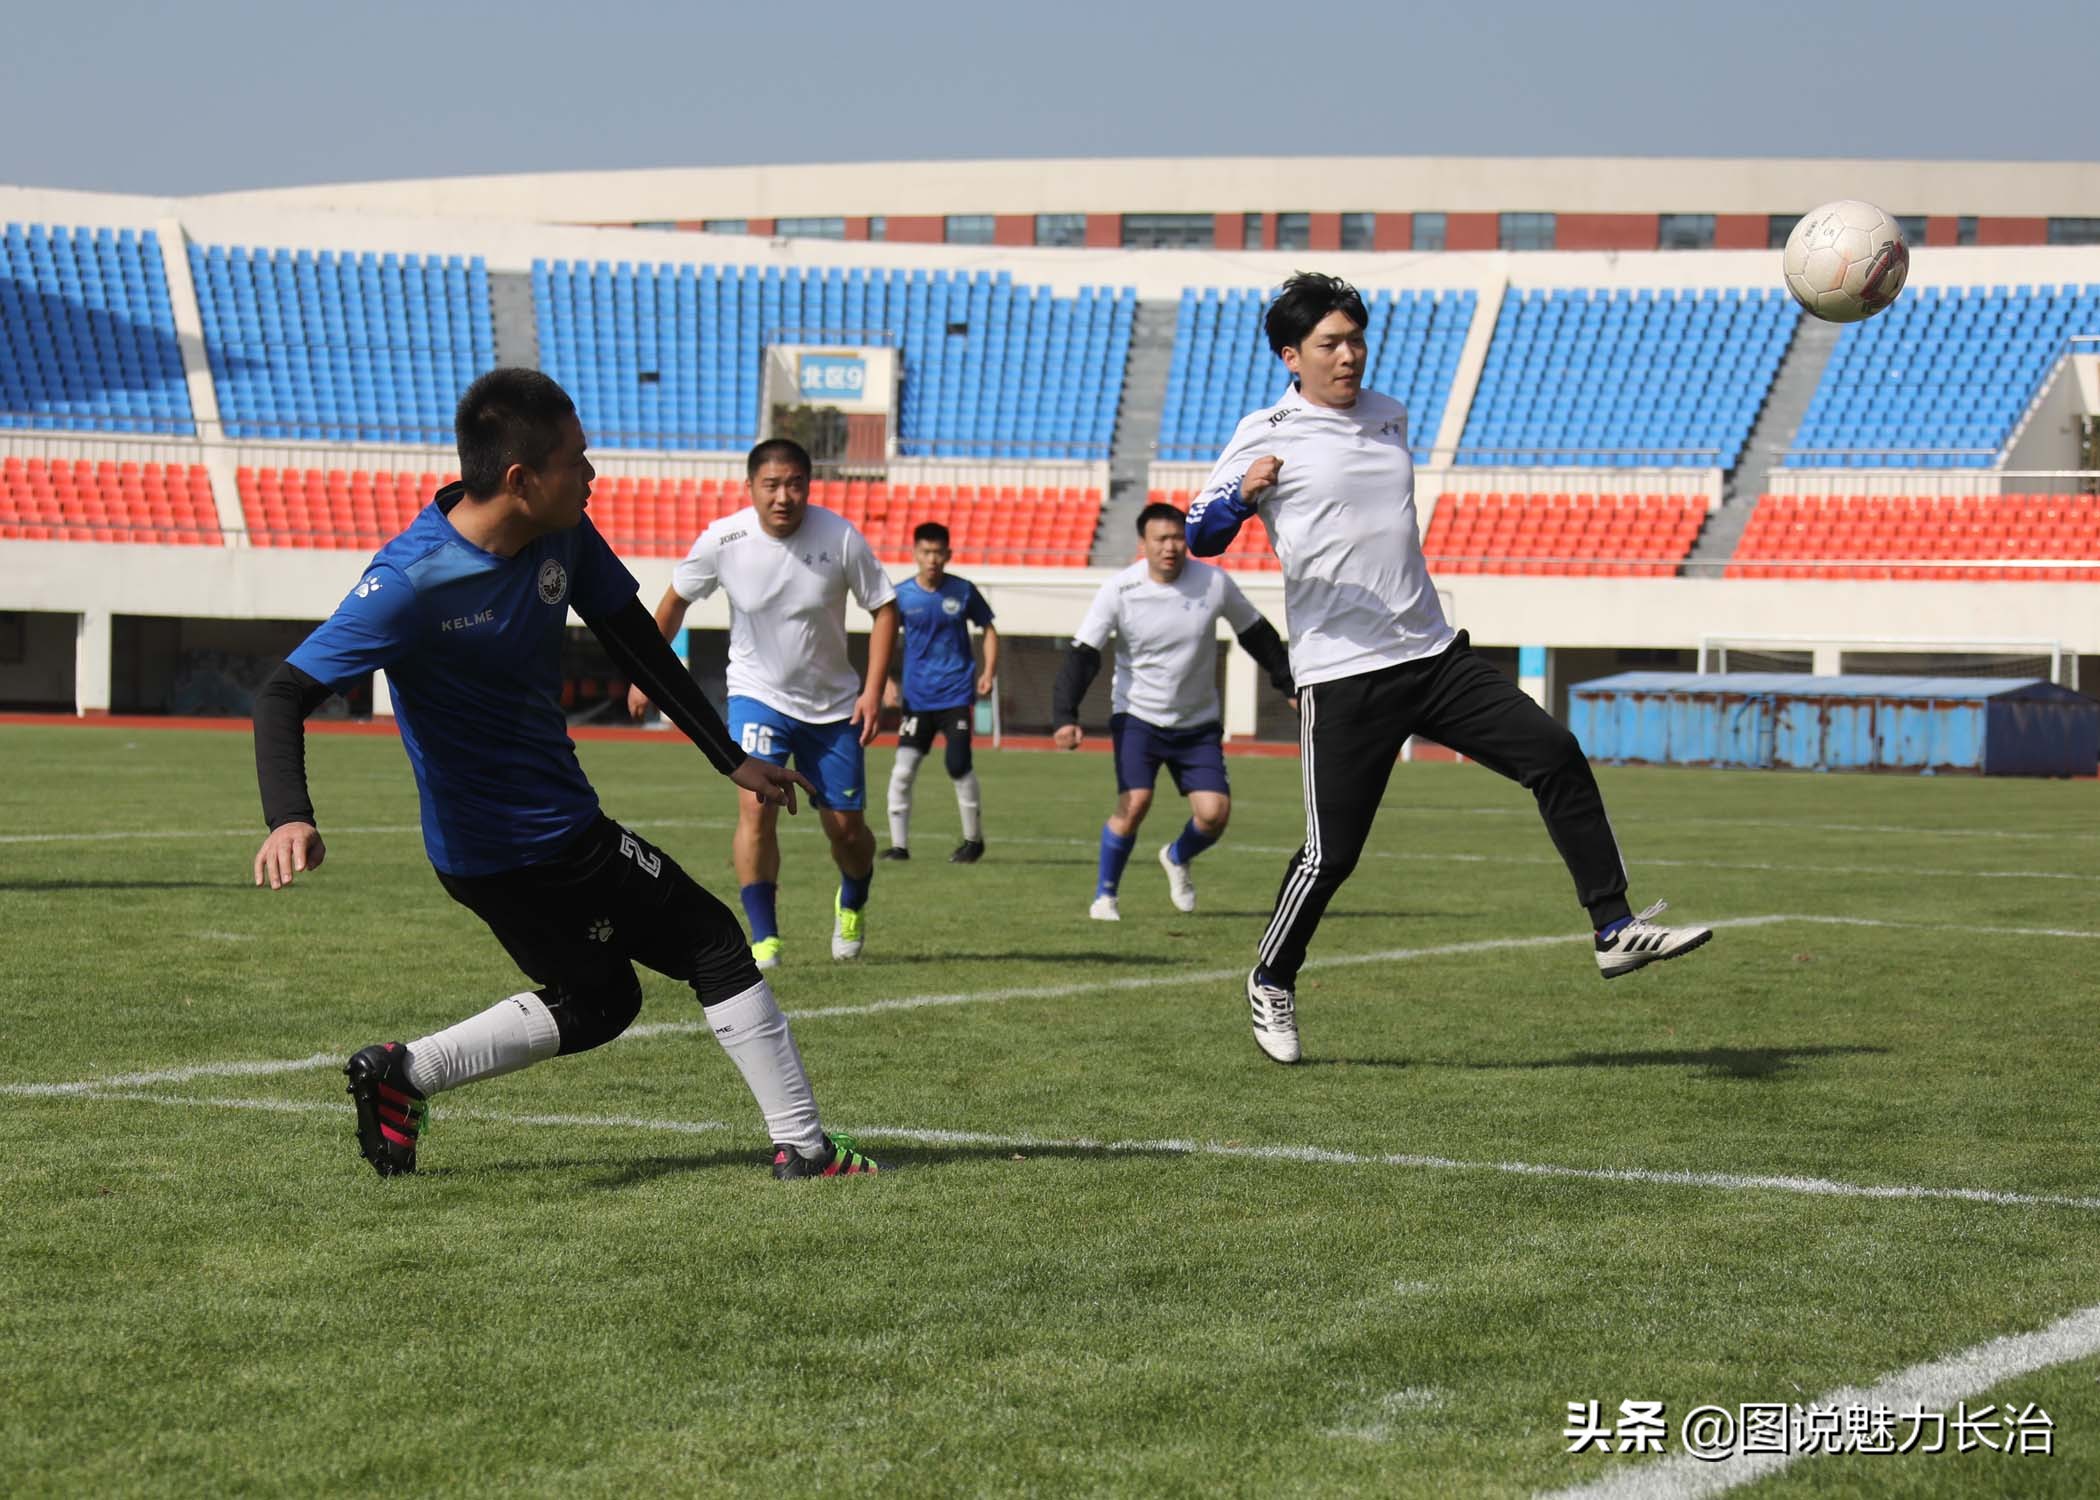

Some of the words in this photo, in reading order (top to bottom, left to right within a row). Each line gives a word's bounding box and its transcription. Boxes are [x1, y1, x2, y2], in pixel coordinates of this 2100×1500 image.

[441, 609, 495, 632] KELME
[741, 723, 774, 755] 56
[619, 833, 661, 878] 2
